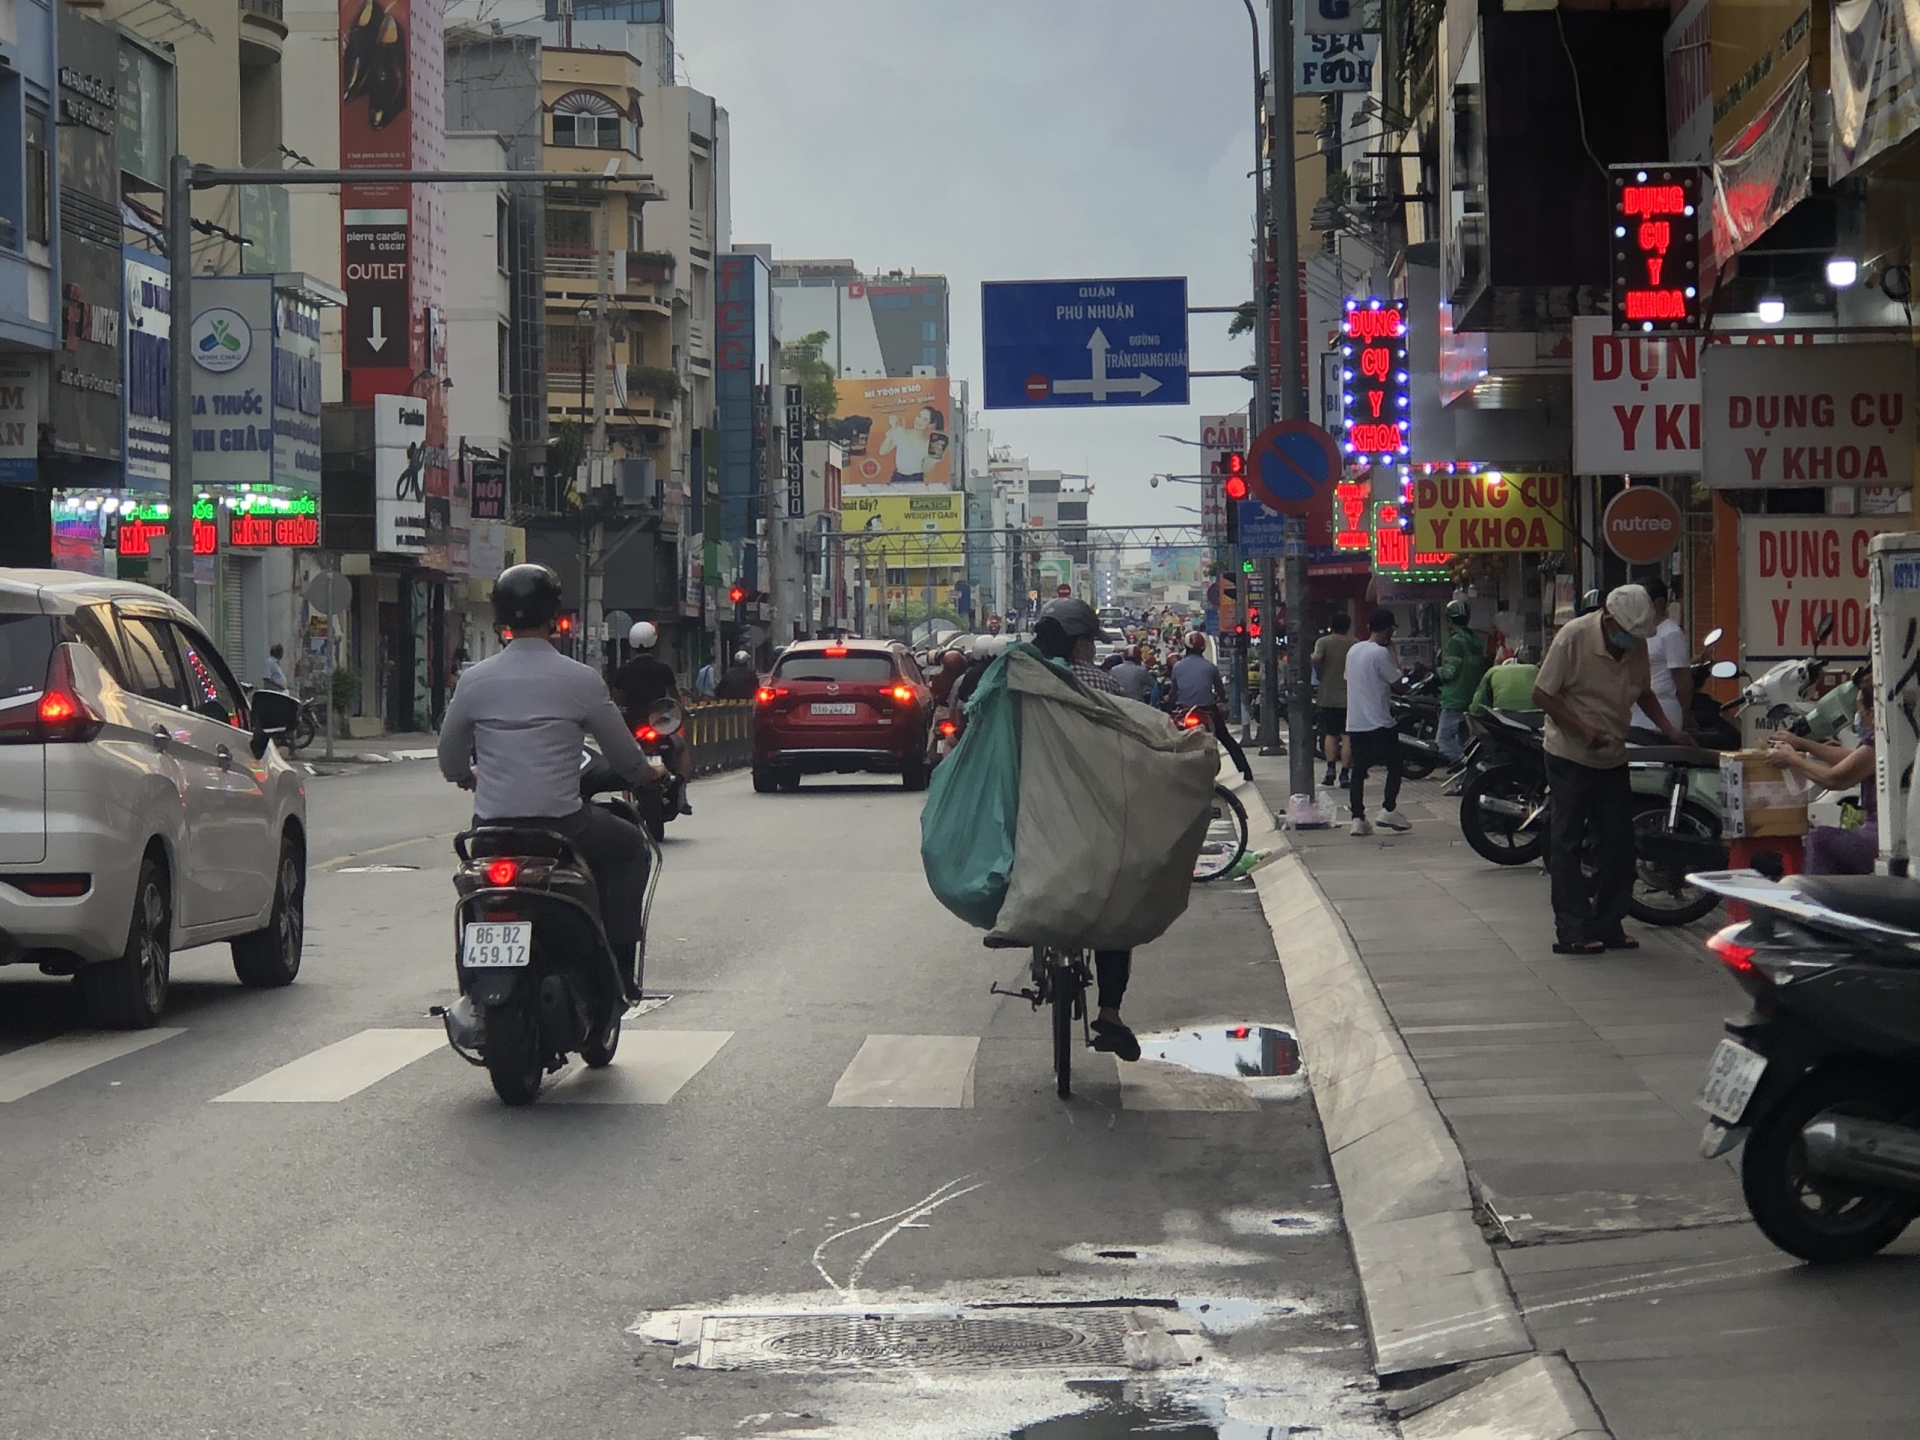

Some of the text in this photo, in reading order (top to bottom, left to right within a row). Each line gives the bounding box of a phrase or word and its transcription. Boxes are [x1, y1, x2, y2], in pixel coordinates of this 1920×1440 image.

[1311, 34, 1364, 53] SEA
[1303, 61, 1372, 85] FOOD
[1623, 186, 1685, 219] DỤNG
[346, 231, 406, 243] pierre cardin
[378, 243, 406, 251] oscar
[1639, 221, 1671, 255] CỤ
[346, 263, 406, 280] OUTLET
[1647, 258, 1664, 286] Y
[1079, 286, 1116, 300] QUẬN
[1626, 290, 1687, 319] KHOA
[1056, 301, 1135, 321] PHÚ NHUẬN
[1349, 310, 1401, 344] DỤNG
[1106, 349, 1131, 369] TRẦN
[1131, 352, 1163, 368] QUANG
[1361, 348, 1390, 382] CỤ
[1592, 335, 1698, 392] DỤN
[212, 388, 263, 415] THUỐC
[789, 388, 800, 439] THE
[1368, 390, 1384, 417] Y
[1728, 393, 1904, 437] DỤNG CỤ
[220, 424, 273, 452] CHÂU
[1350, 423, 1401, 451] KHOA
[1613, 405, 1645, 451] Y
[1744, 445, 1890, 481] Y KHOA
[1417, 477, 1510, 516] DỤNG
[1520, 476, 1560, 516] CỤ
[275, 514, 317, 545] CHÂU
[904, 511, 958, 520] WEIGHT GAIN
[1612, 516, 1673, 533] nutree
[1429, 516, 1549, 549] Y KHOA
[1759, 529, 1841, 589] DỤNG
[1771, 599, 1791, 647] Y
[468, 945, 526, 964] 459.12
